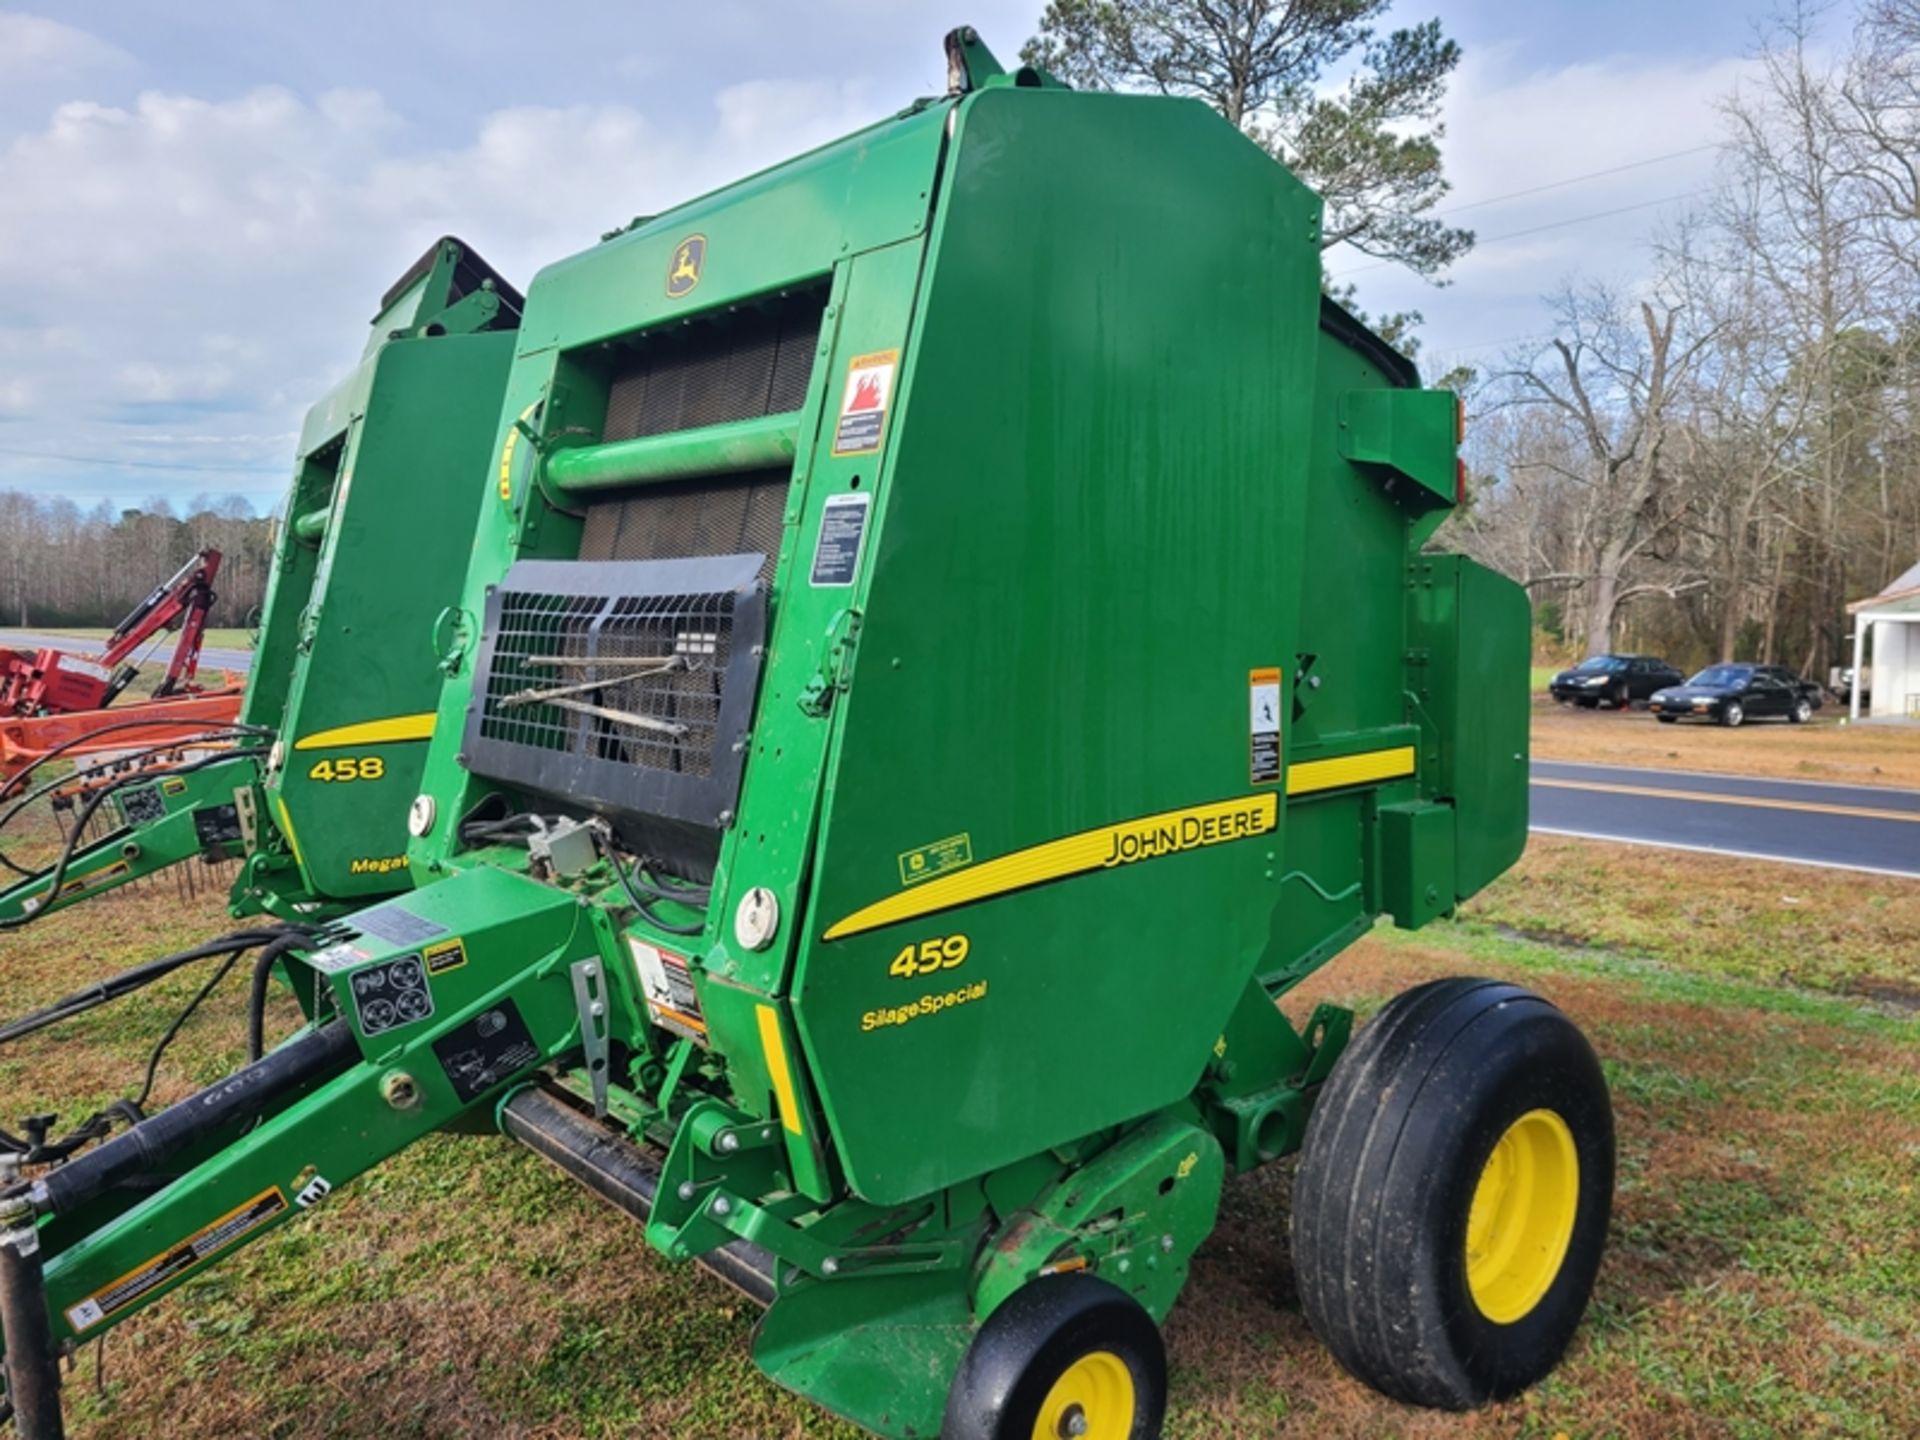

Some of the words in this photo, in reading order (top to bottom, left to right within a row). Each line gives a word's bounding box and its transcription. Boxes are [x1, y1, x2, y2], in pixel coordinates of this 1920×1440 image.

[309, 756, 385, 782] 458
[1104, 825, 1177, 863] JOHN
[1181, 807, 1264, 845] DEERE
[889, 933, 970, 978] 459
[861, 979, 988, 1031] SilageSpecial
